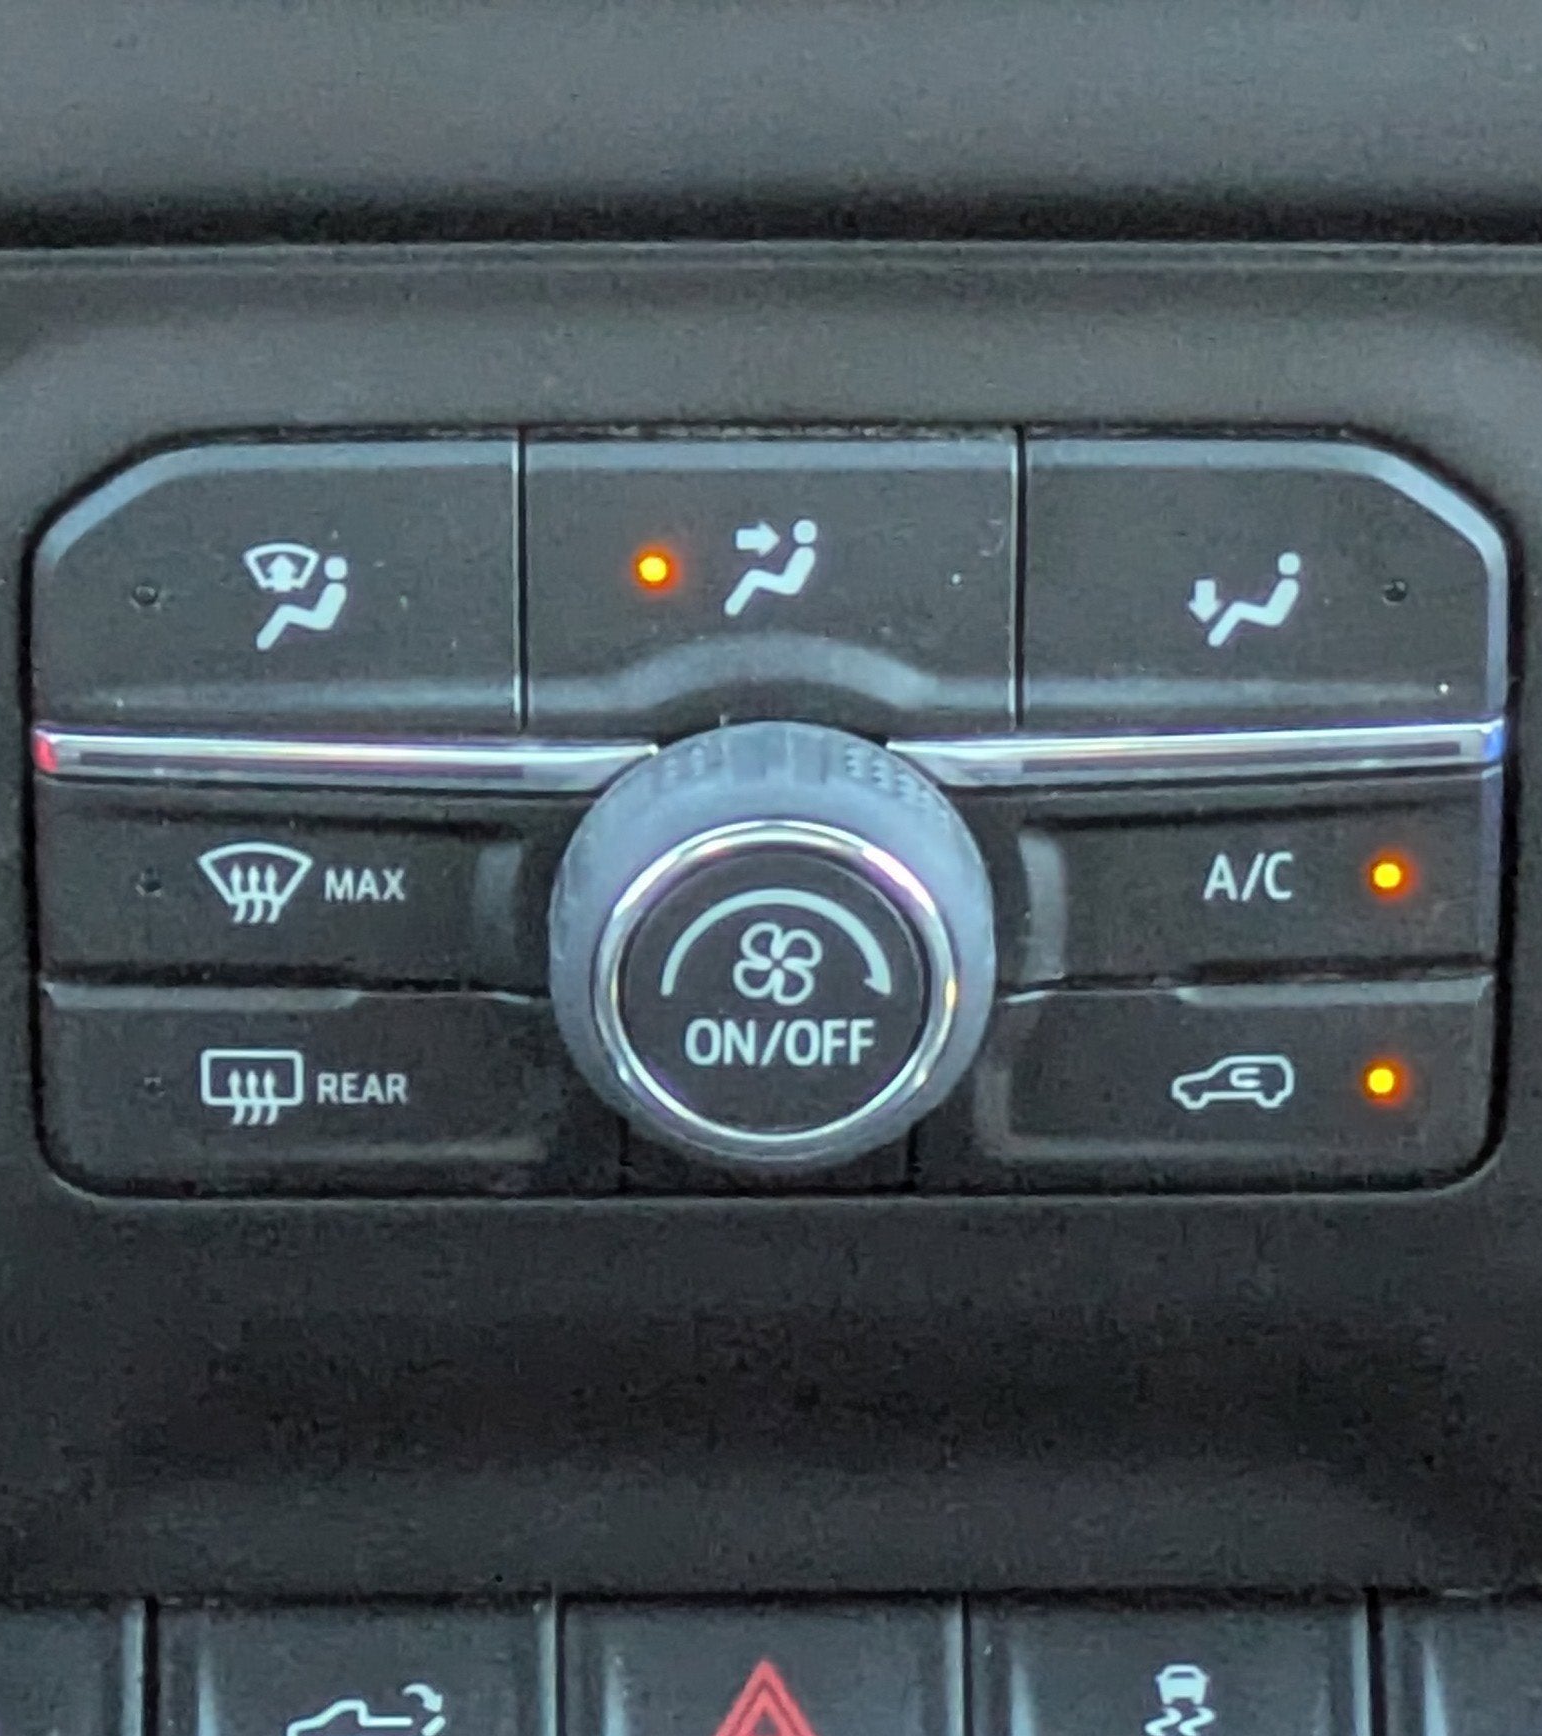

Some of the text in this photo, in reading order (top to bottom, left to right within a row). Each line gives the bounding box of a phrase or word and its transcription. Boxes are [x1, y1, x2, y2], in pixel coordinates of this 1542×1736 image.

[325, 868, 405, 900] MAX
[1204, 852, 1293, 901] A/C
[685, 1018, 874, 1066] ON/OFF
[317, 1072, 407, 1104] REAR
